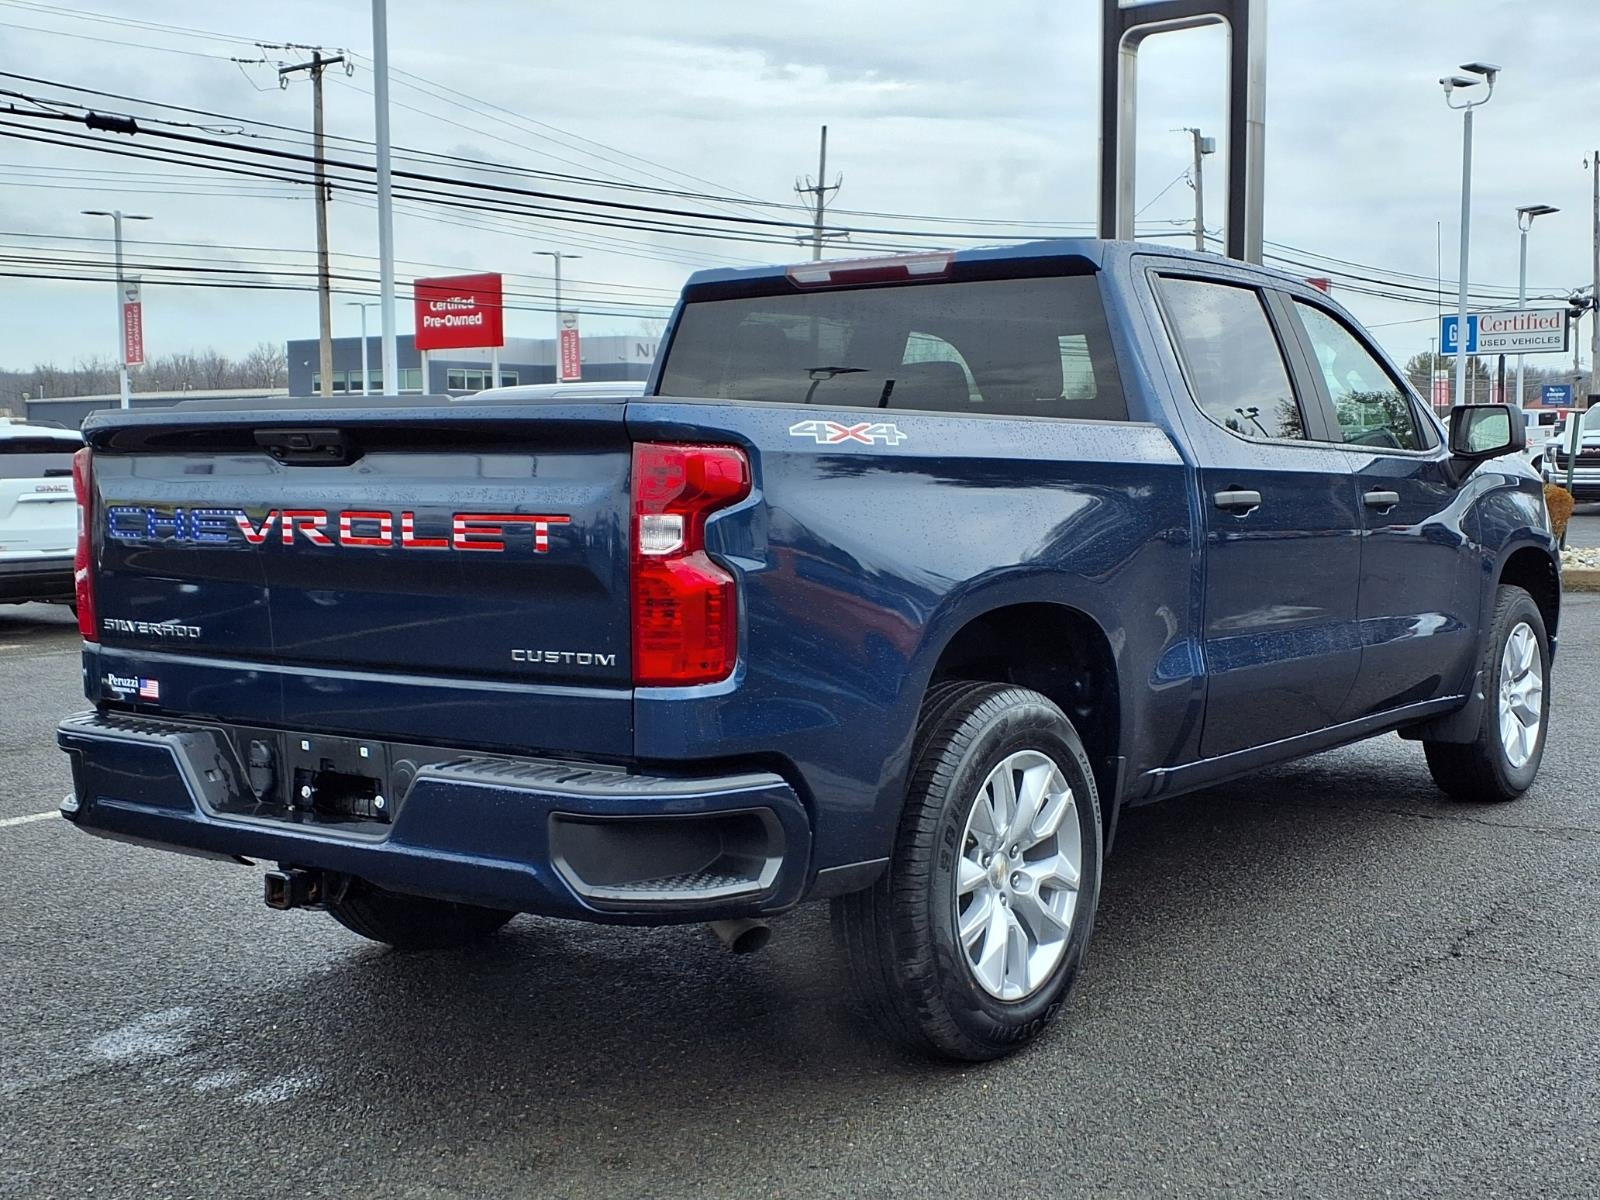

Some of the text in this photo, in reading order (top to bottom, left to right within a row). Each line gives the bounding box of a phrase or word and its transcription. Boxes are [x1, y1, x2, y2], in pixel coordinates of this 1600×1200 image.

[430, 296, 475, 311] Certified
[423, 312, 482, 328] Pre-Owned
[1480, 311, 1560, 333] Certified
[133, 305, 141, 362] PRE-OWNED
[1480, 335, 1561, 347] USED VEHICLES
[35, 485, 69, 493] GMC
[107, 505, 571, 554] CHEVROLET
[103, 618, 202, 638] SILVERADO
[511, 649, 616, 667] CUSTOM
[108, 673, 139, 688] Peruzzi
